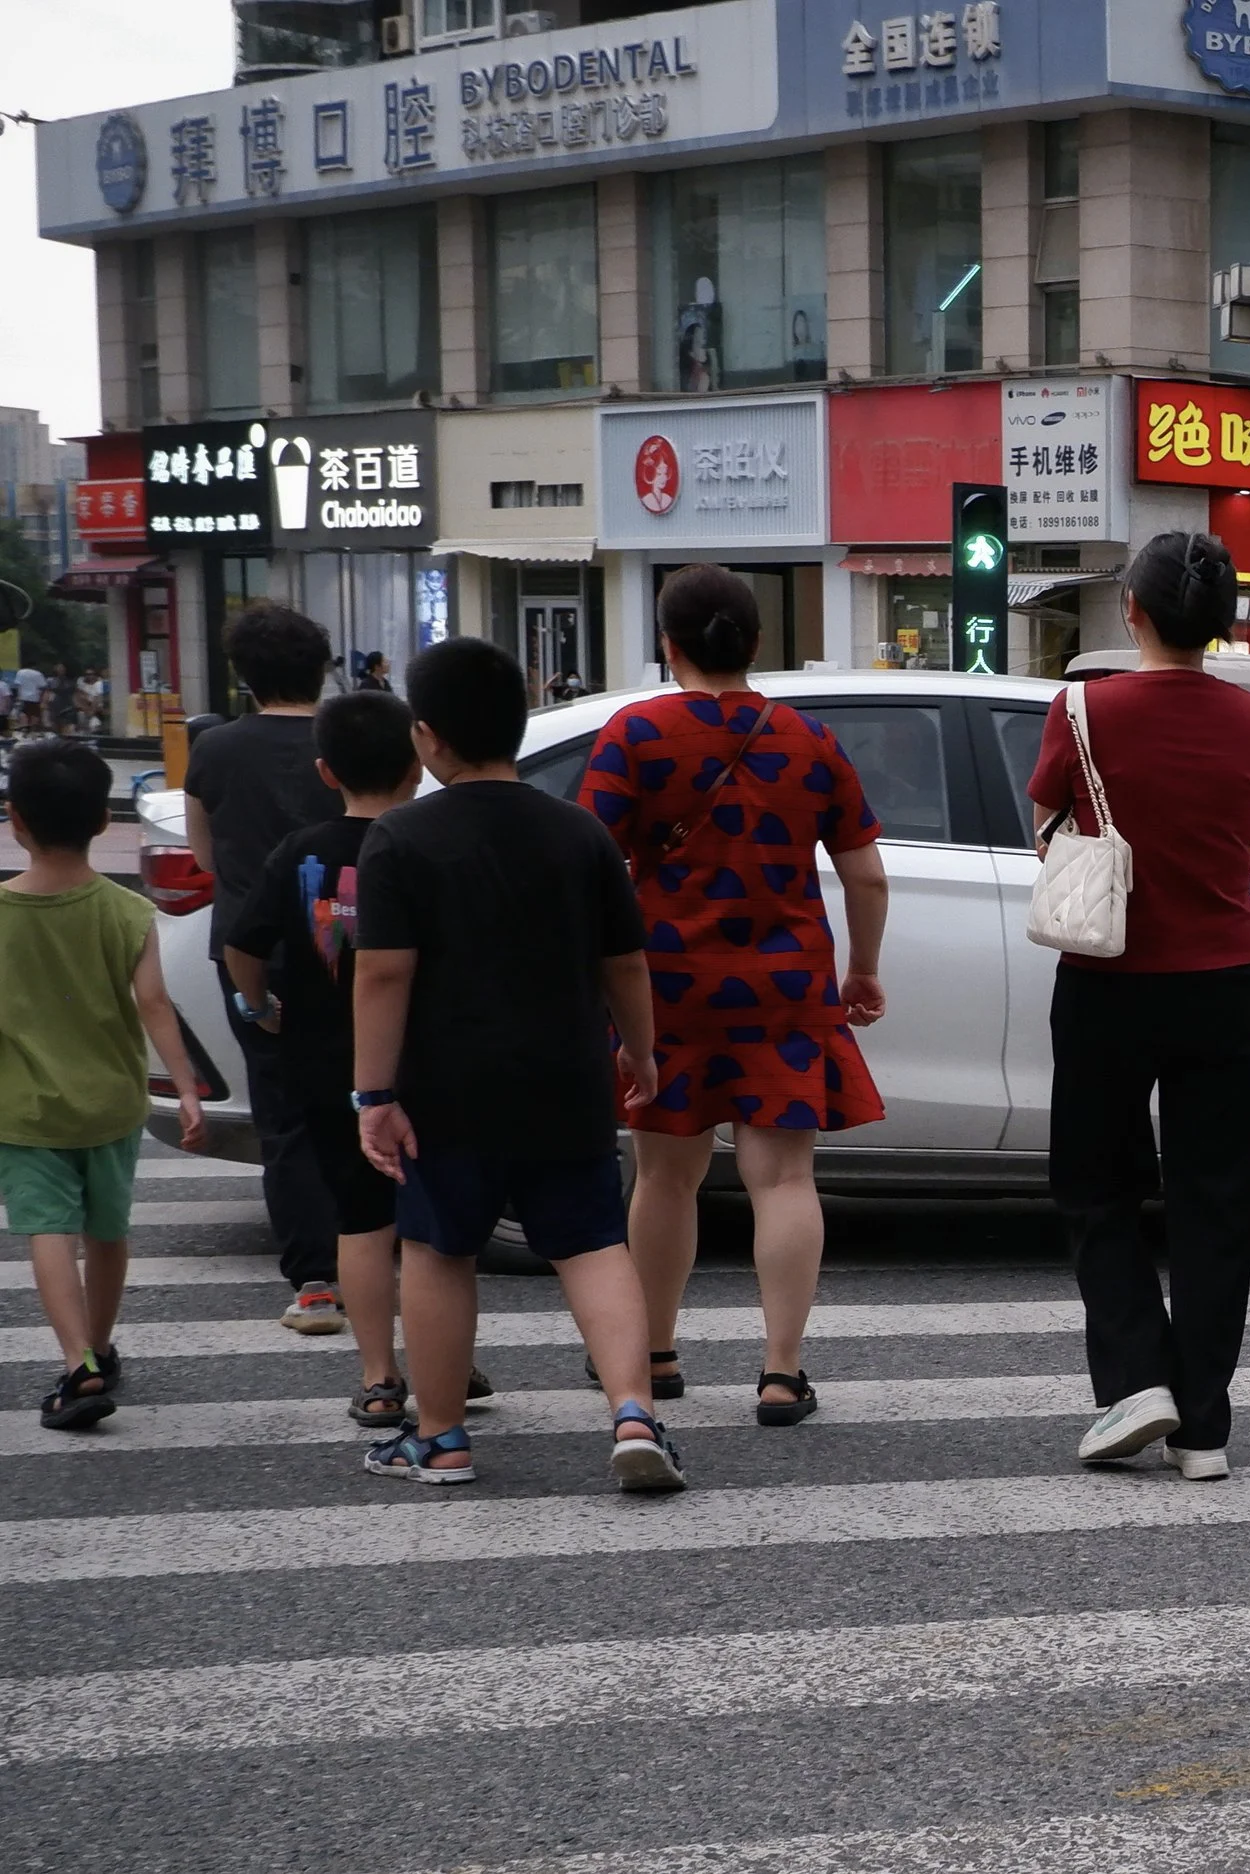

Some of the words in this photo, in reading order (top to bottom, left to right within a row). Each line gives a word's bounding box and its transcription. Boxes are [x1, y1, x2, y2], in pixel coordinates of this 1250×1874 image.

[842, 1, 1001, 76] 全国连锁
[170, 76, 436, 206] 拜博口腔
[319, 444, 420, 490] 茶百道
[1009, 443, 1098, 477] 手机维修
[321, 498, 422, 529] Chabaidao
[1010, 491, 1028, 504] 换屏
[1033, 491, 1051, 504] 配件
[1056, 490, 1074, 503] 回收
[1080, 489, 1098, 503] 贴膜
[1038, 516, 1099, 528] 18991861088
[966, 616, 995, 675] 行人
